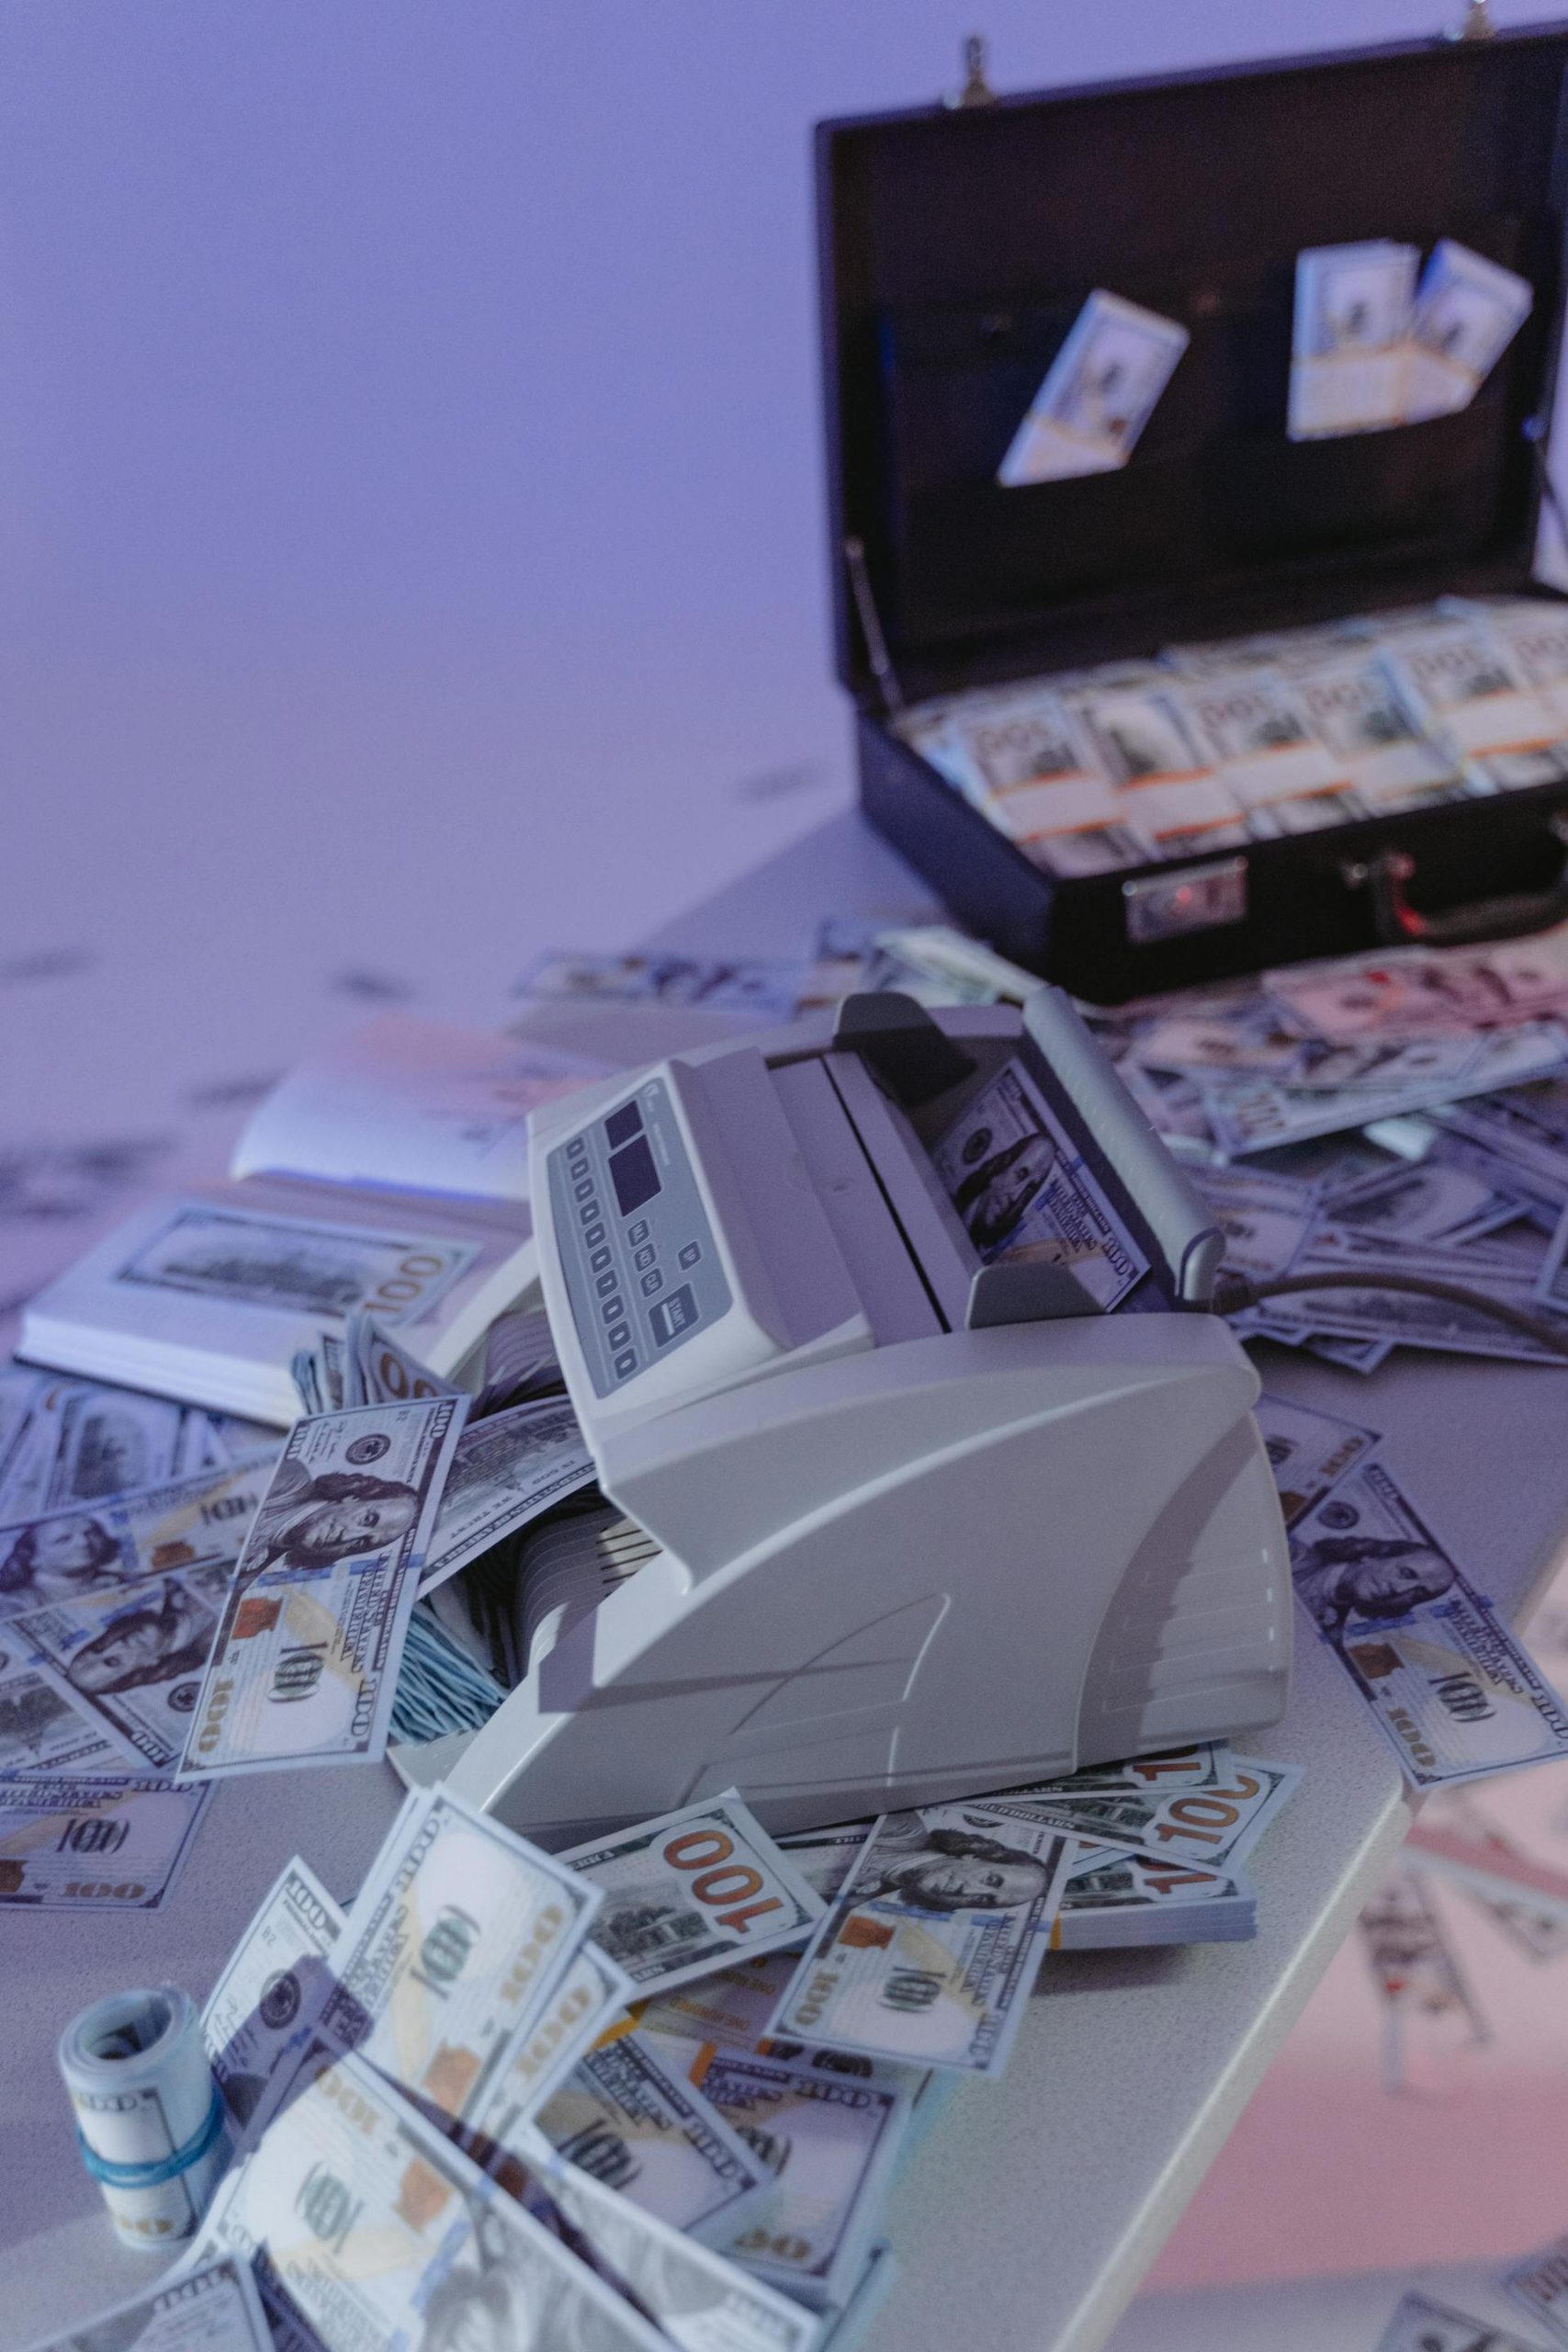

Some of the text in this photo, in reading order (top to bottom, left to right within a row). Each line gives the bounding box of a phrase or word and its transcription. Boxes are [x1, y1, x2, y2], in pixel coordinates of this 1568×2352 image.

[585, 1208, 596, 1217] 4
[602, 1278, 613, 1288] 7
[1102, 1234, 1132, 1276] 100
[365, 1255, 443, 1314] 100
[668, 1296, 687, 1329] START
[286, 1423, 310, 1460] 100
[429, 1402, 455, 1439] 100
[1318, 1435, 1364, 1476] 100
[450, 1510, 491, 1541] TRUST
[267, 1640, 330, 1703] 100
[1427, 1670, 1497, 1724] 100
[198, 1678, 235, 1753] 100
[350, 1678, 378, 1736] 100
[1529, 1694, 1568, 1739] 100
[130, 1730, 171, 1767] 100
[1386, 1707, 1437, 1768] 100
[56, 1818, 130, 1854] 100
[399, 1816, 442, 1894] 100
[63, 1882, 147, 1900] 100
[284, 1878, 328, 1929] 100
[662, 1828, 784, 1935] 100
[408, 1903, 483, 2001] 100
[499, 1903, 564, 2008] 100
[794, 1973, 839, 2026] 100
[877, 1964, 949, 2014] 100
[516, 1984, 592, 2083] 100
[314, 2065, 379, 2137] 100
[794, 2079, 872, 2109] 100
[556, 2117, 644, 2189] 100
[681, 2113, 736, 2178] 100
[294, 2159, 366, 2256] 100
